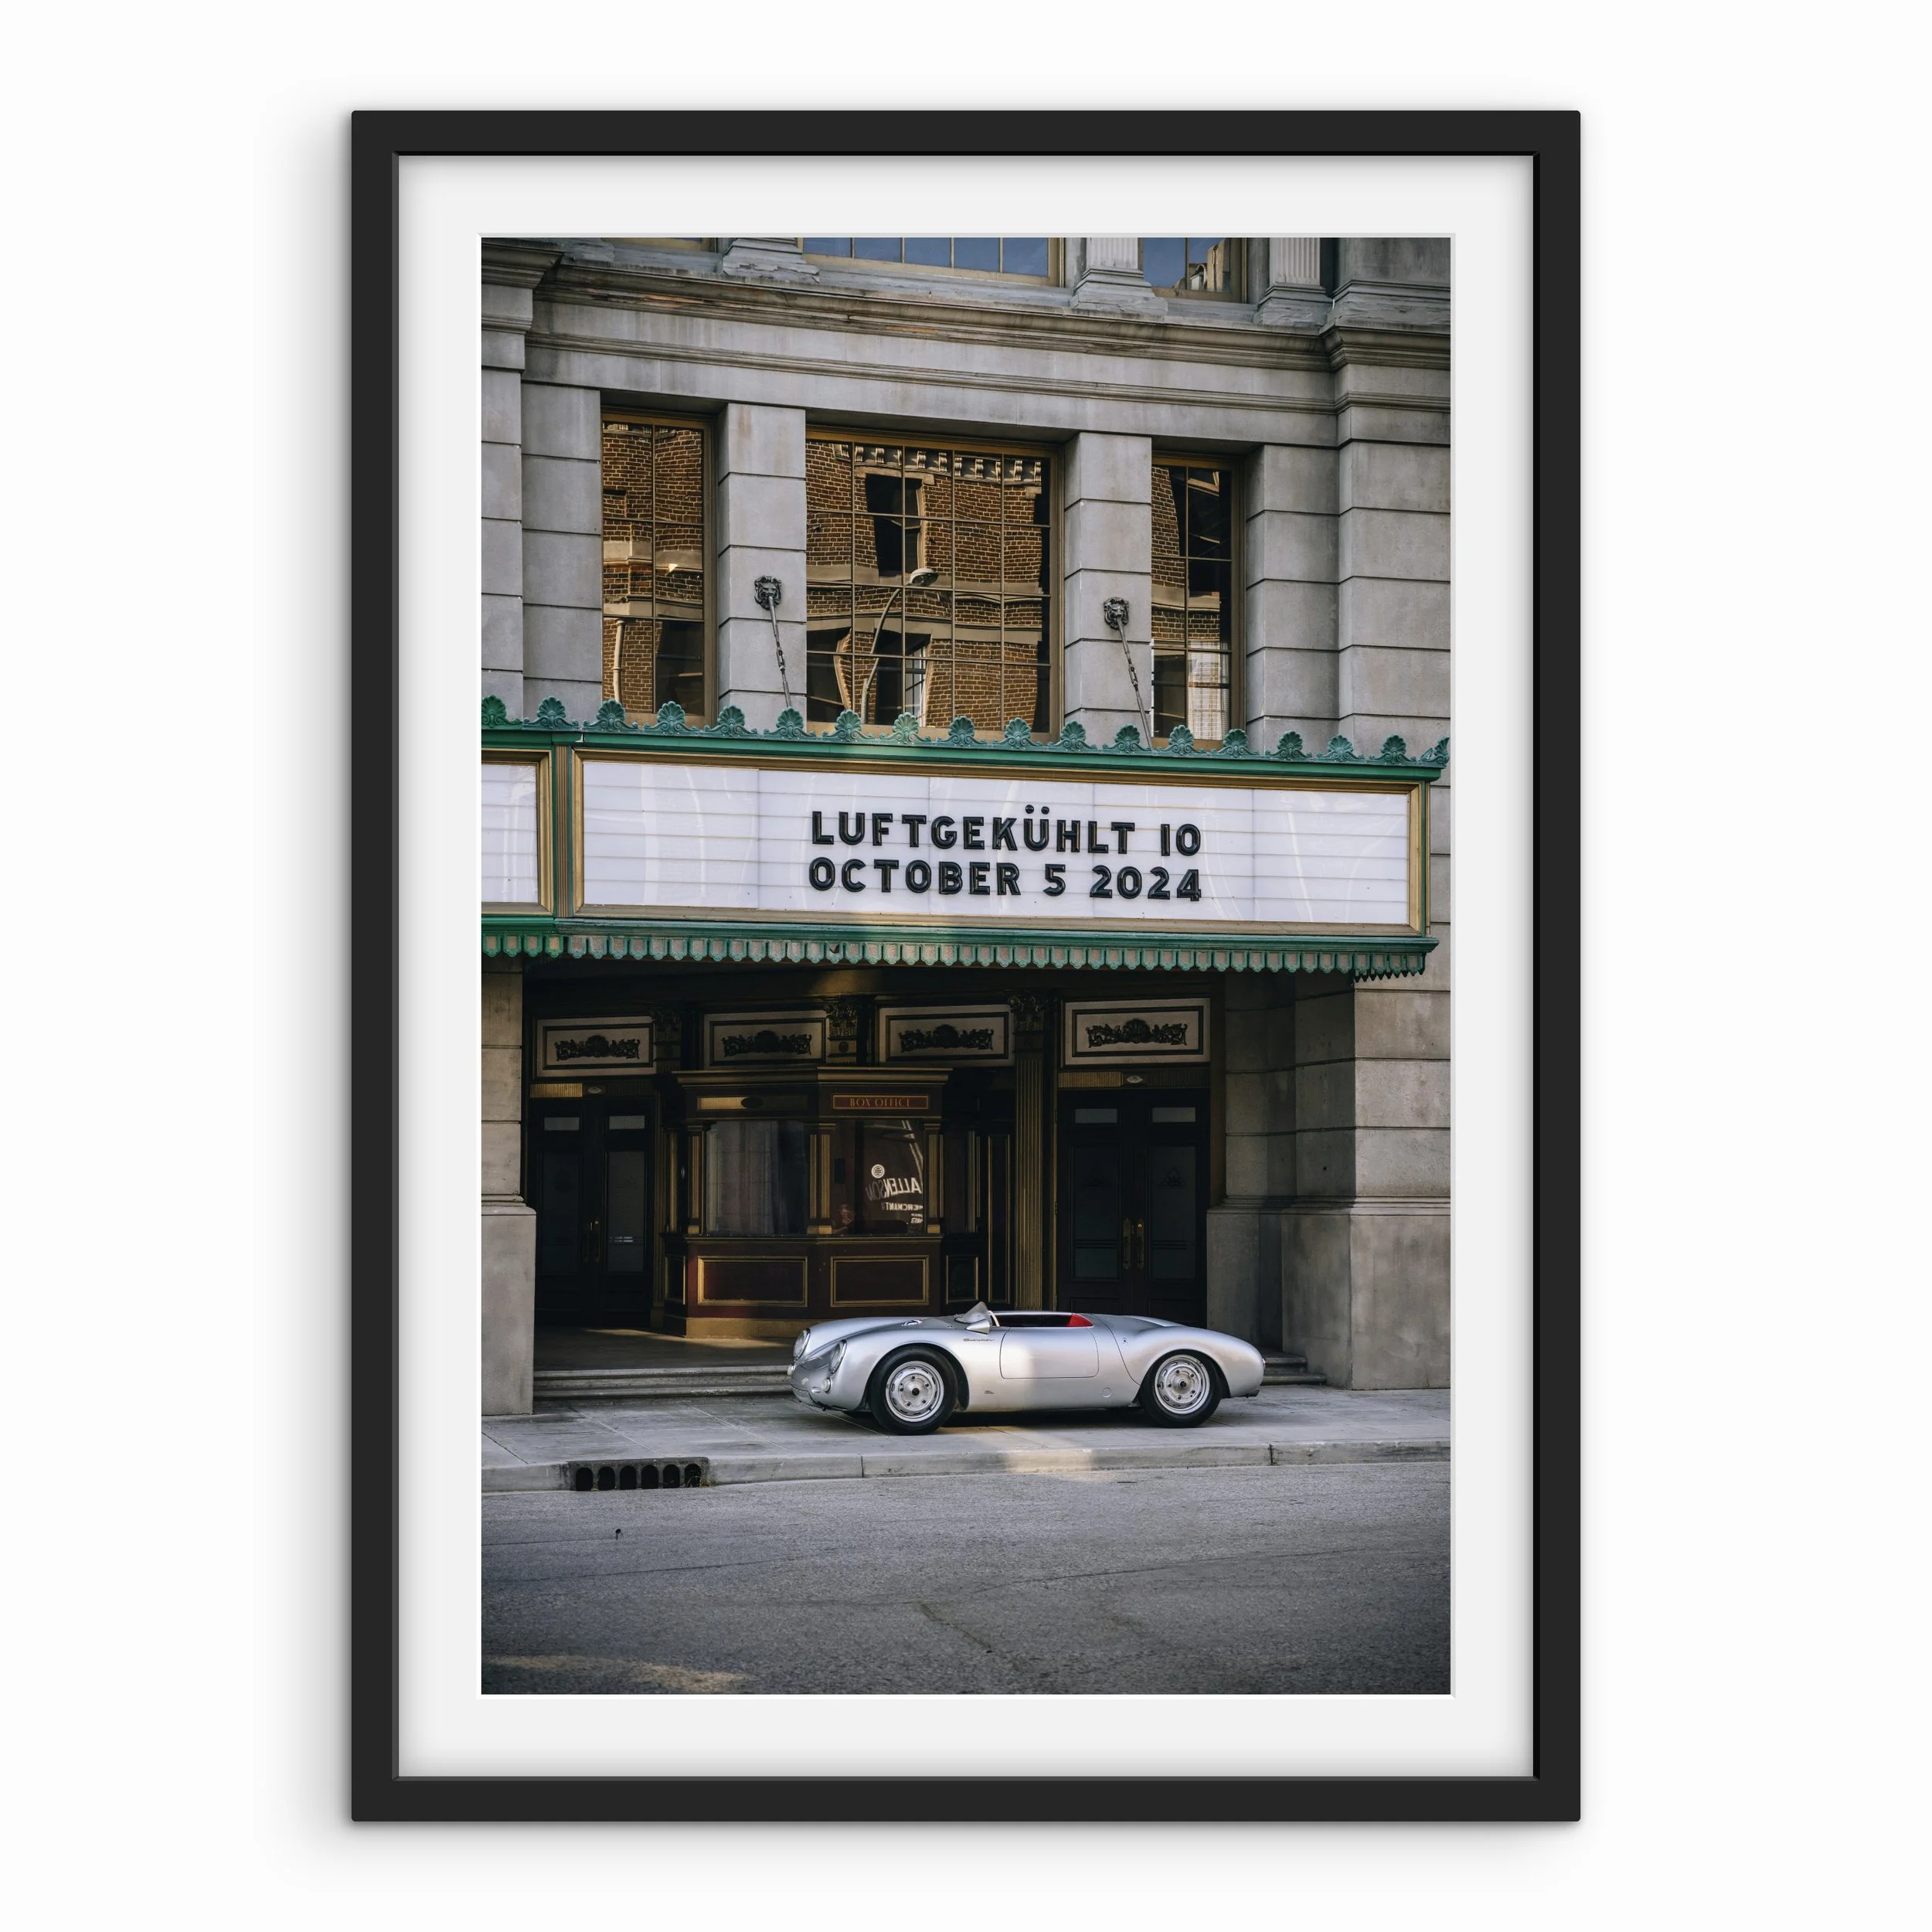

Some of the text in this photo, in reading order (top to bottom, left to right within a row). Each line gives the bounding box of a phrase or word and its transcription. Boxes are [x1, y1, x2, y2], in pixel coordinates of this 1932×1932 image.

[811, 804, 1202, 856] LUFTGEKÜHLT 10
[809, 857, 1202, 901] OCTOBER 5 2024
[850, 1098, 910, 1107] BOX OFFICE
